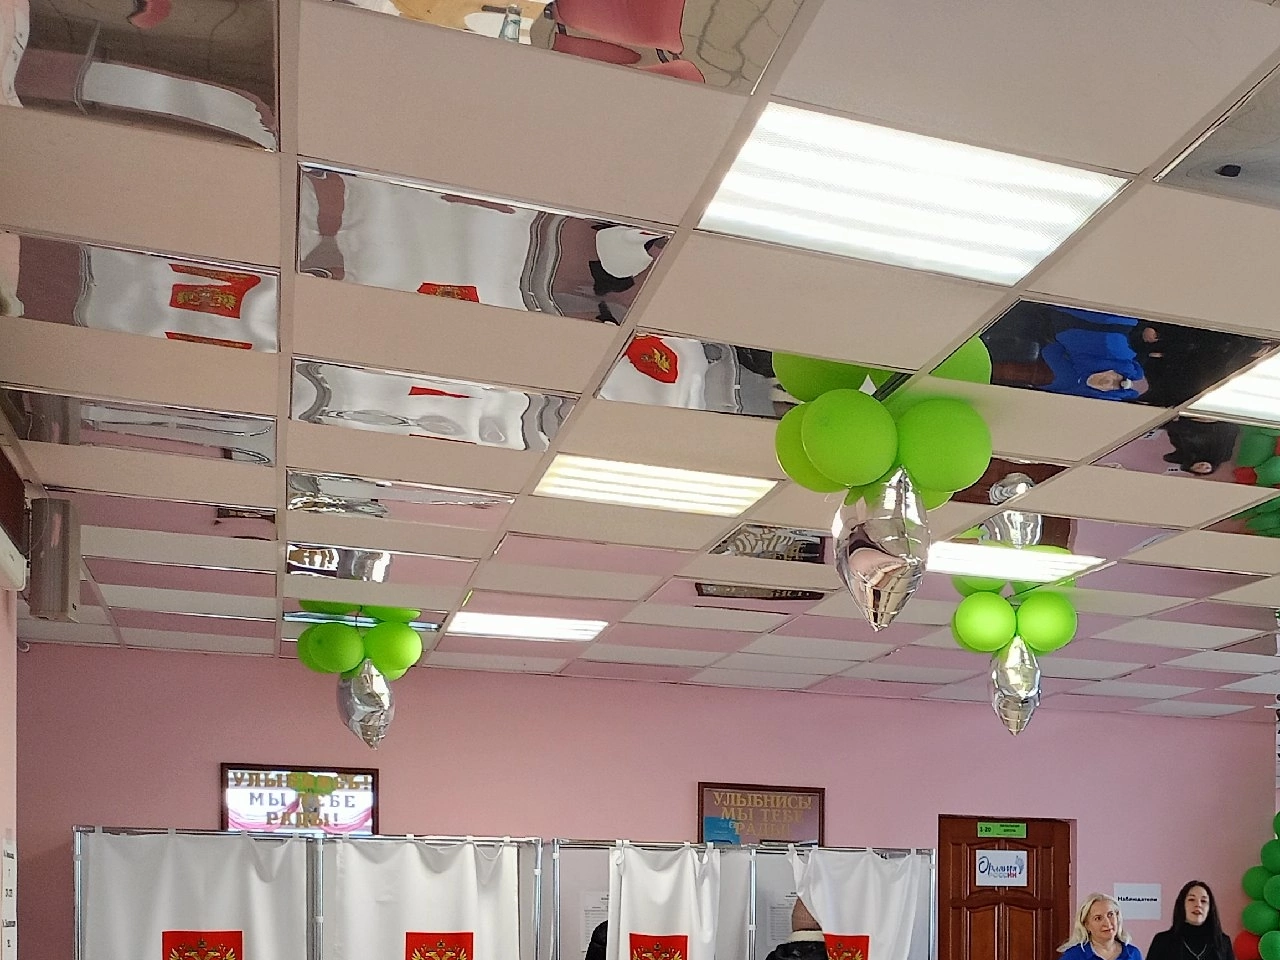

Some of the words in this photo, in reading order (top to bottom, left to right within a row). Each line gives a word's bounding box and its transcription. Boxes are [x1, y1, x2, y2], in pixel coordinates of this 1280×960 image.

[249, 792, 286, 806] МЫ
[713, 792, 812, 809] УЛЫБНИСЬ!
[721, 806, 754, 820] МЫ
